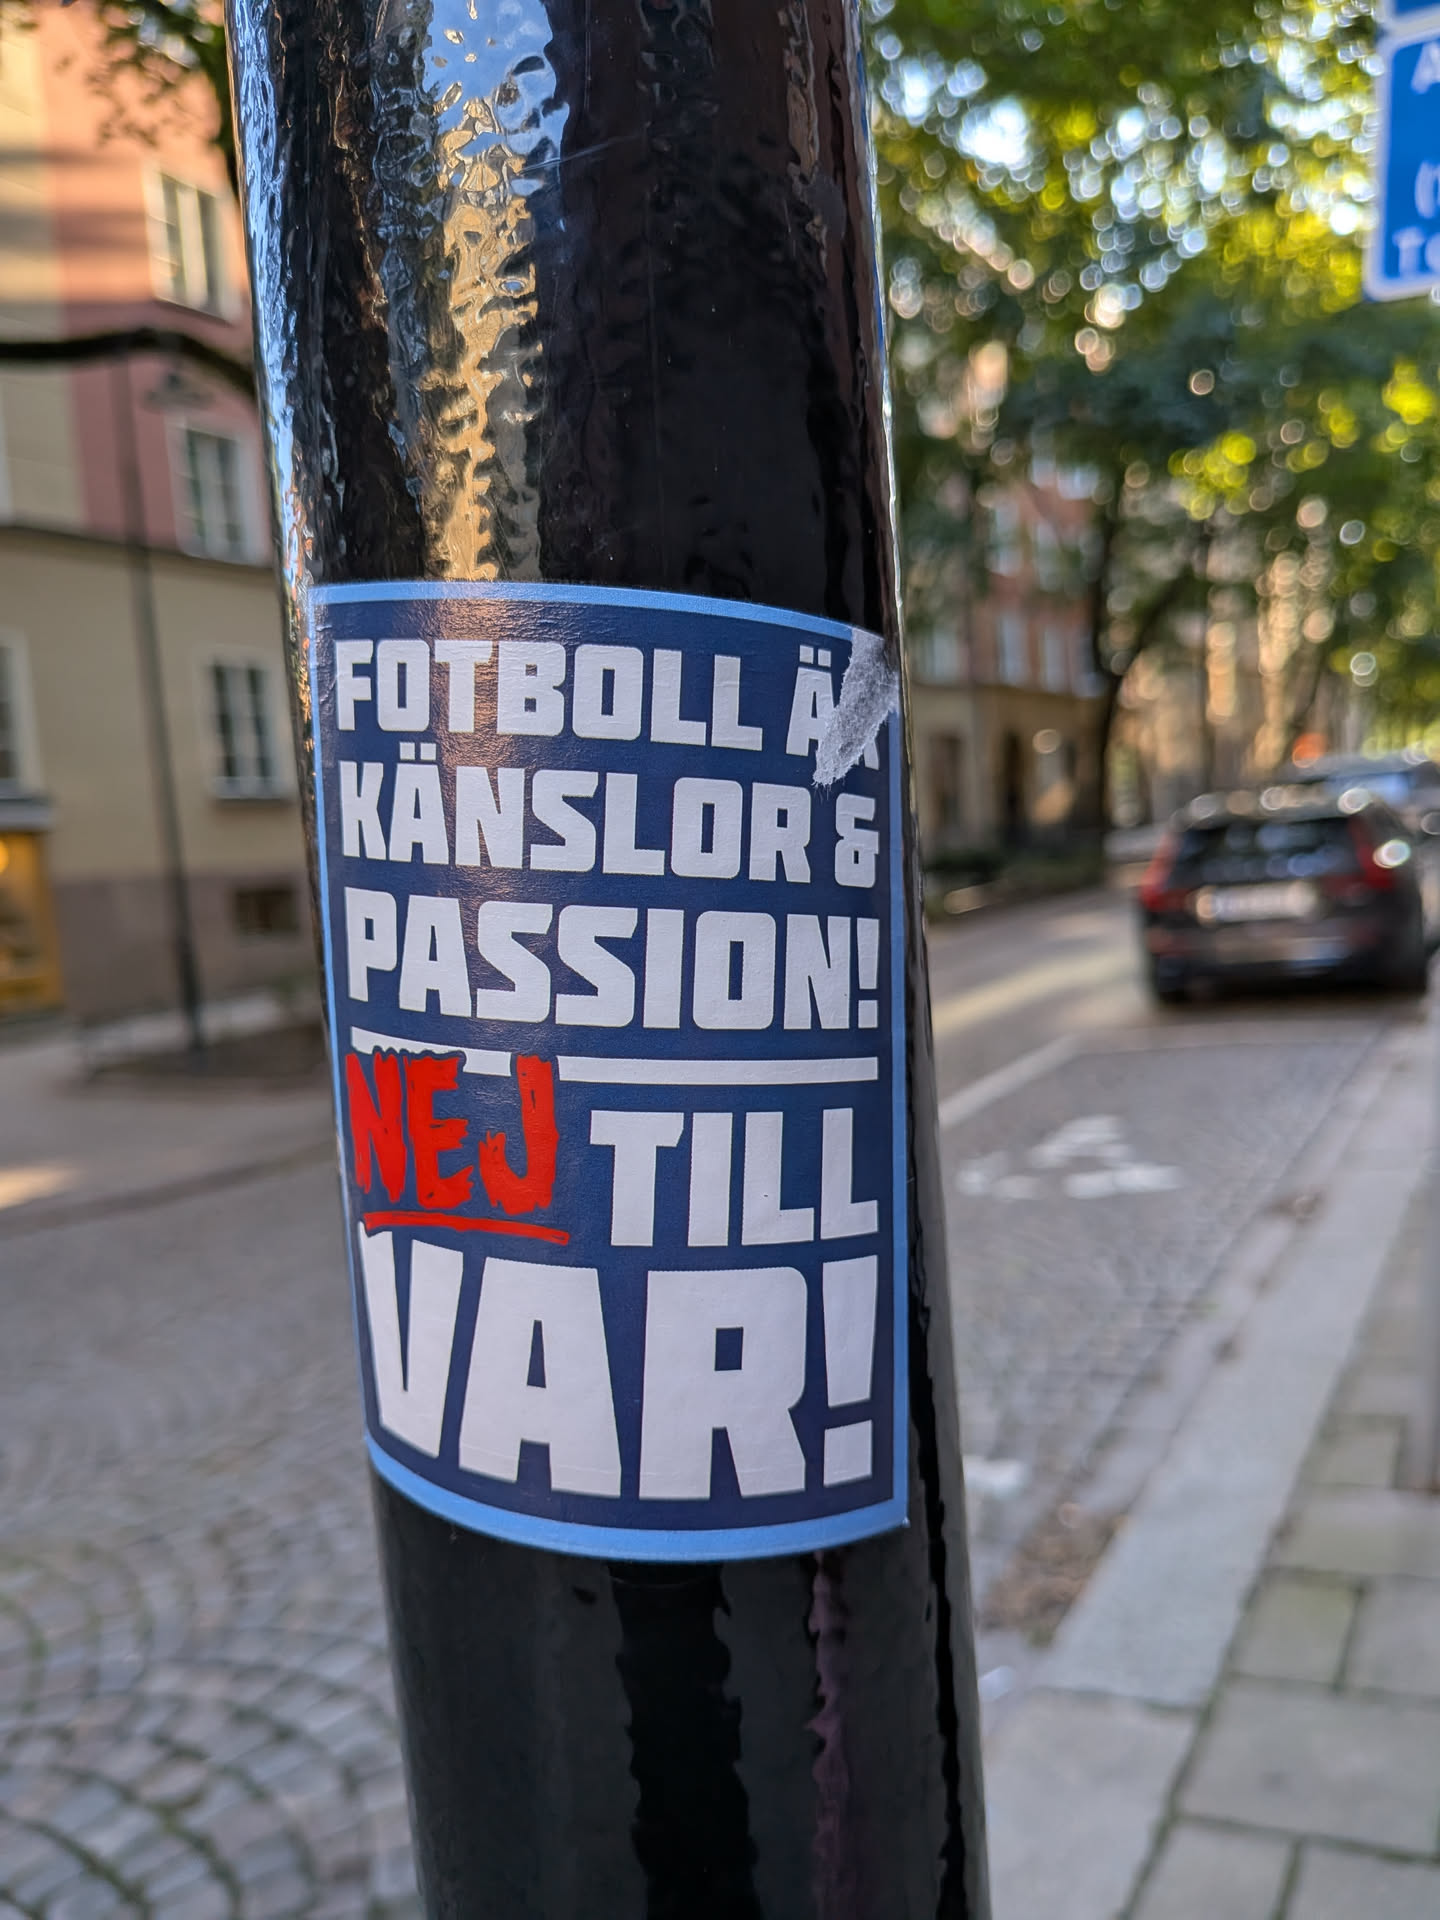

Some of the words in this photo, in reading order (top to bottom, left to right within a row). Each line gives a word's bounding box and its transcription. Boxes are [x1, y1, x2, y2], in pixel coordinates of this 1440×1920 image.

[335, 639, 764, 752] FOTBOLL
[785, 644, 880, 771] Ä
[338, 742, 812, 884] KÄNSLOR
[834, 793, 879, 888] &
[344, 886, 880, 1030] PASSION!
[345, 1054, 559, 1215] NEJ
[589, 1107, 879, 1248] TILL
[358, 1221, 879, 1500] VAR!
